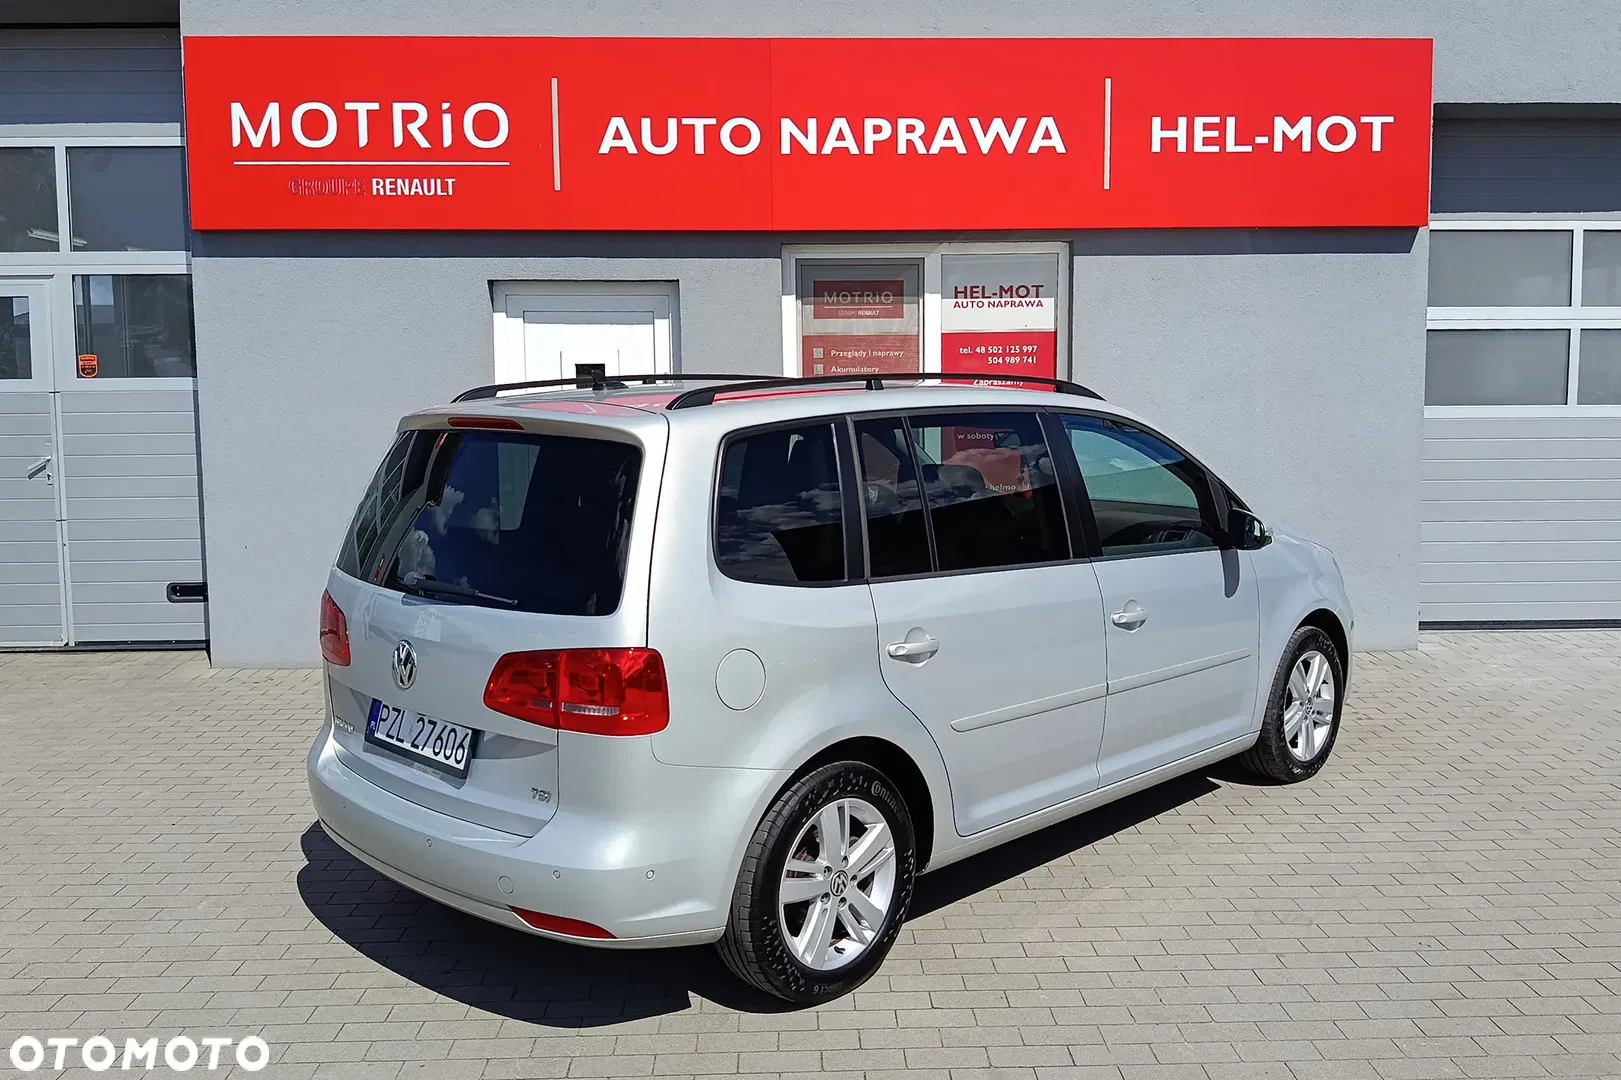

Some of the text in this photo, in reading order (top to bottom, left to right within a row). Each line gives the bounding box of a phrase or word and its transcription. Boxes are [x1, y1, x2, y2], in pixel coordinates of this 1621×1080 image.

[230, 102, 510, 149] MOTRiO
[598, 116, 1067, 155] AUTO NAPRAWA
[1150, 115, 1395, 153] HEL-MOT
[288, 177, 457, 196] GROUPE RENAULT
[954, 285, 1044, 299] HEL-MOT
[953, 300, 1043, 308] AUTO NAPRAWA
[872, 350, 904, 358] naprawy
[959, 345, 1038, 354] tel. 48 502 125 997
[987, 356, 1037, 364] 504 989 741
[830, 366, 879, 374] Akumulatory
[966, 432, 994, 441] soboty
[370, 720, 376, 730] PL
[376, 704, 406, 744] PZL
[410, 716, 470, 765] 27606
